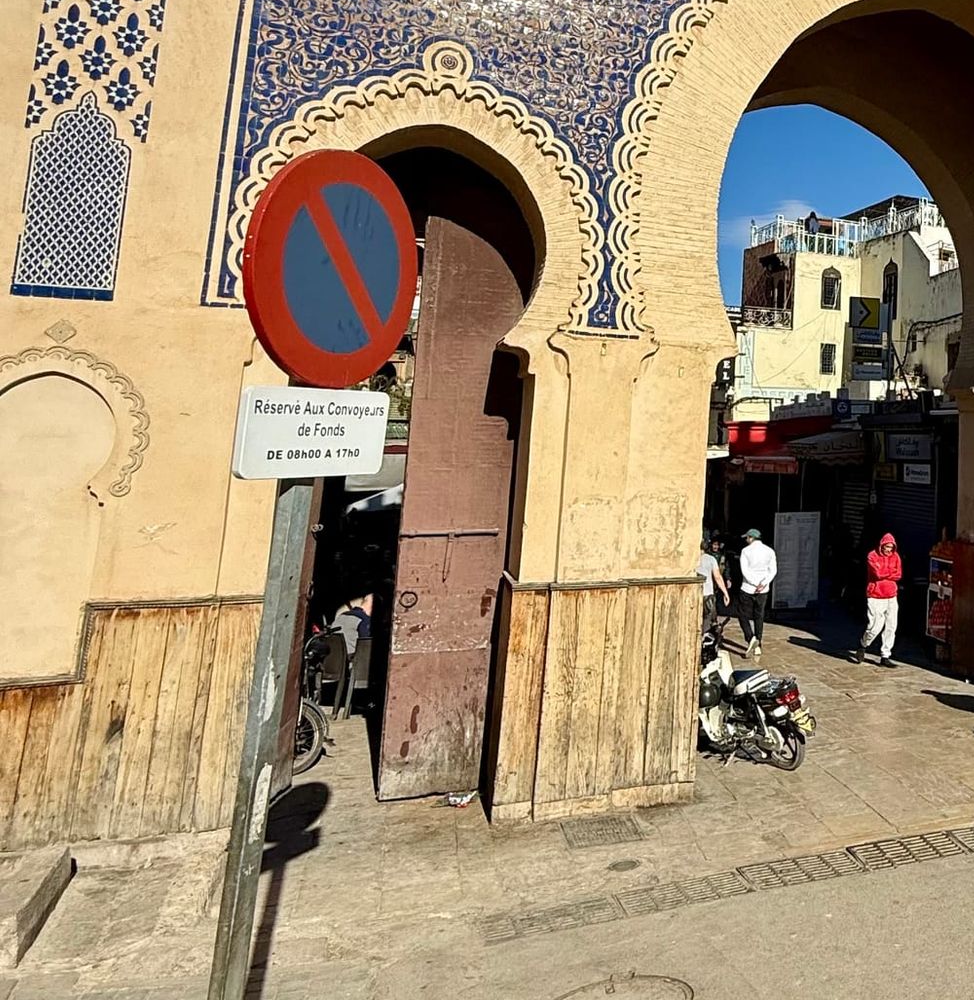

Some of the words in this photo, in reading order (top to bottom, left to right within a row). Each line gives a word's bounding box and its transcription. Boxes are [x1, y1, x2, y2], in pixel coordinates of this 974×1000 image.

[254, 399, 301, 415] Réservé
[303, 401, 325, 415] Aux
[327, 402, 385, 419] Convoyeurs
[297, 422, 311, 437] de
[313, 422, 345, 437] Fonds
[267, 450, 283, 460] DE
[287, 449, 321, 459] 08h00
[324, 449, 332, 458] A
[336, 448, 360, 458] 17h0
